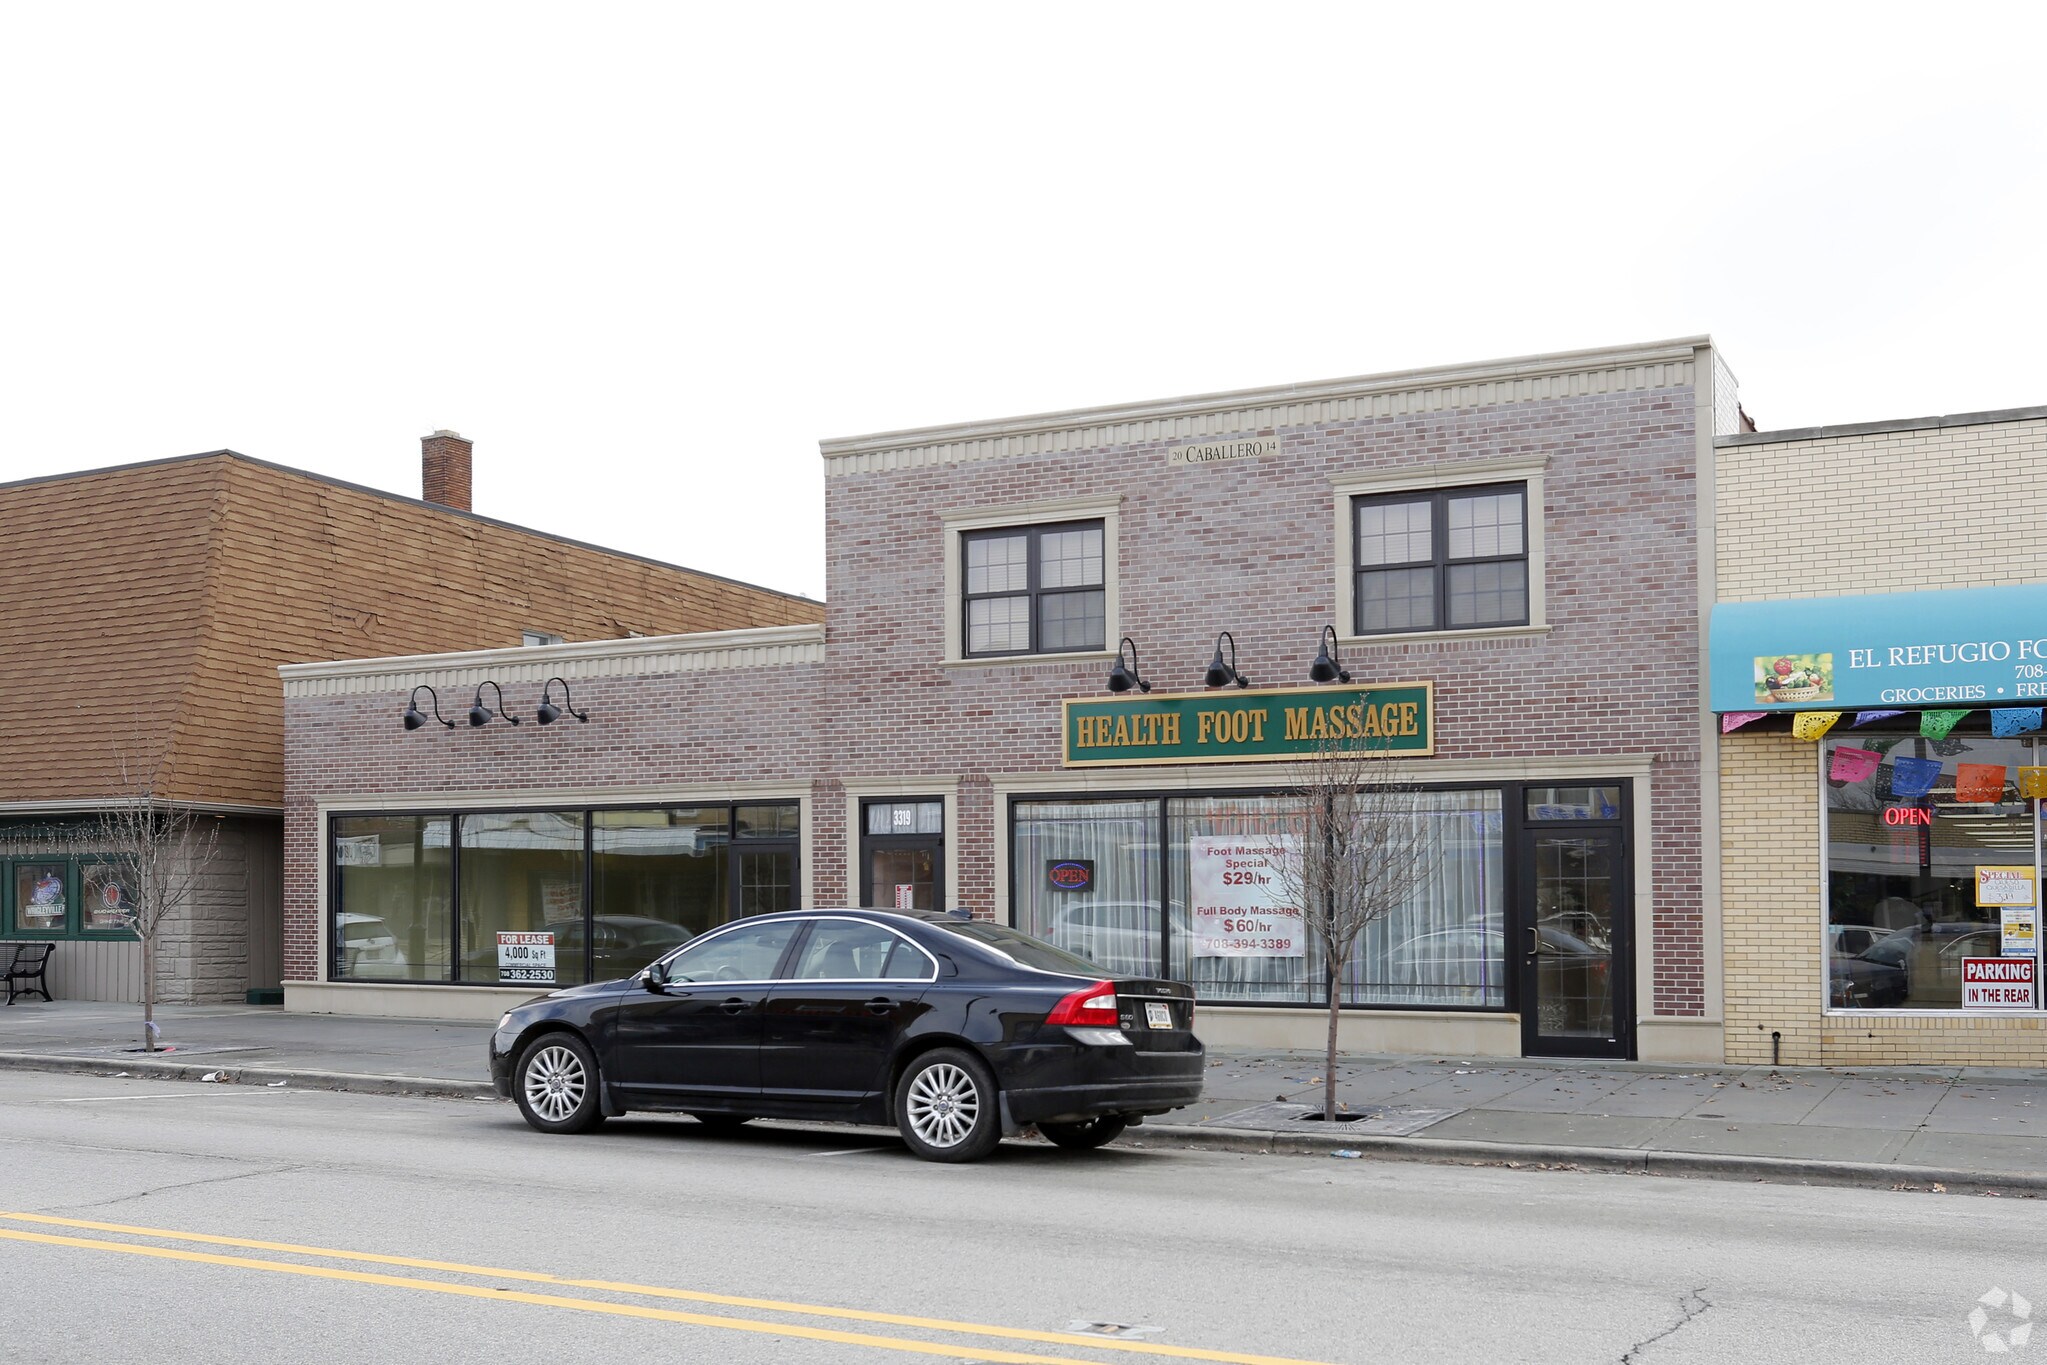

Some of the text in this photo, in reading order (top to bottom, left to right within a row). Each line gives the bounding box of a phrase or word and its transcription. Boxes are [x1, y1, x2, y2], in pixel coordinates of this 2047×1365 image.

[1173, 441, 1276, 463] 20 CABALLERO 14
[1849, 648, 1881, 669] EL
[1888, 641, 2011, 668] REFUGIO
[1881, 684, 1986, 703] GROCERIES
[1077, 701, 1418, 748] HEALTH FOOT MASSAGE
[893, 809, 911, 826] 3319
[1884, 807, 1931, 826] OPEN
[1207, 846, 1286, 857] Foot Massage
[1225, 859, 1268, 870] Special
[1049, 869, 1089, 882] OPEN
[1223, 871, 1272, 886] $29/hr
[1197, 906, 1300, 918] Full Body Massage
[501, 935, 549, 945] FOR LEASE
[1205, 938, 1291, 949] 708-394-3389
[505, 947, 546, 960] 4,000 Sq Ft
[510, 969, 554, 980] 362-2530
[1967, 963, 2031, 980] PARKING
[1968, 988, 2030, 1002] IN THE REAR
